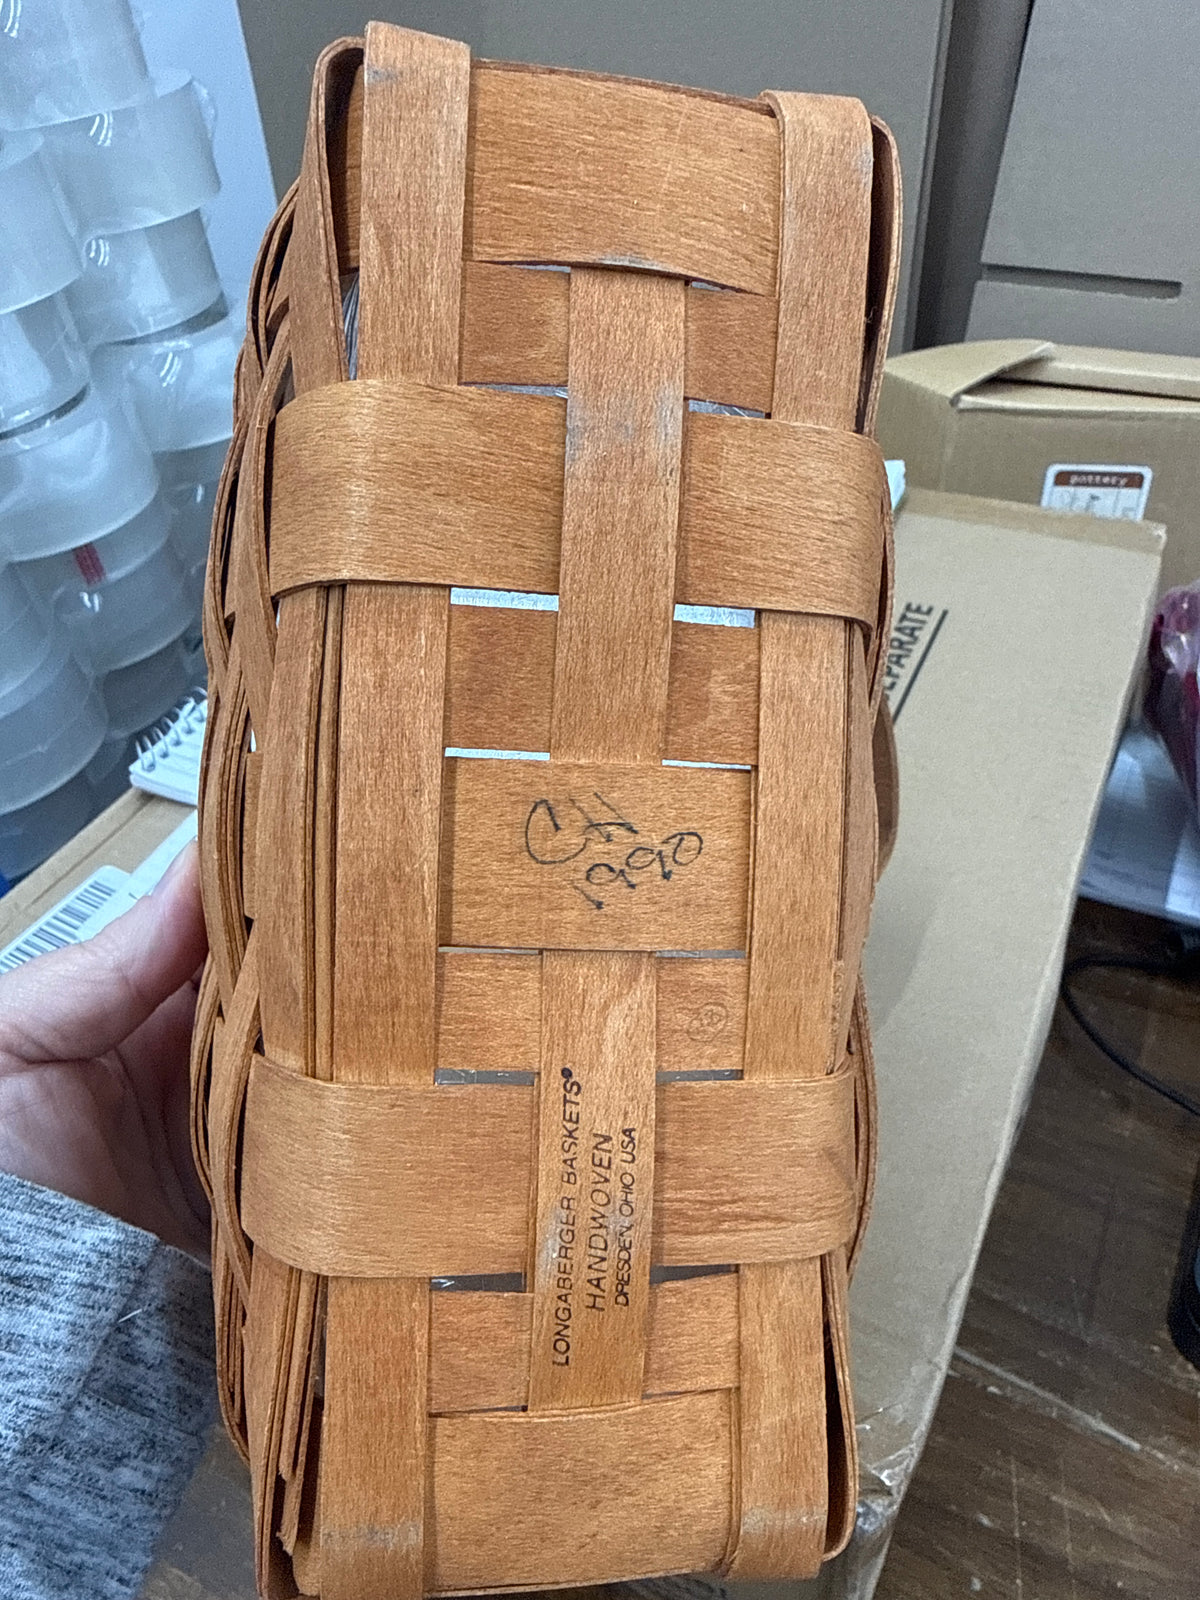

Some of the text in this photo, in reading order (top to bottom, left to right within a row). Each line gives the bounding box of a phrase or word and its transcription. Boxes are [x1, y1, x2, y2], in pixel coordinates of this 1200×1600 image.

[618, 1172, 636, 1218] OHIO
[620, 1127, 637, 1164] USA
[585, 1132, 613, 1312] HANDWOVEN
[551, 1196, 576, 1367] LONGABERGER
